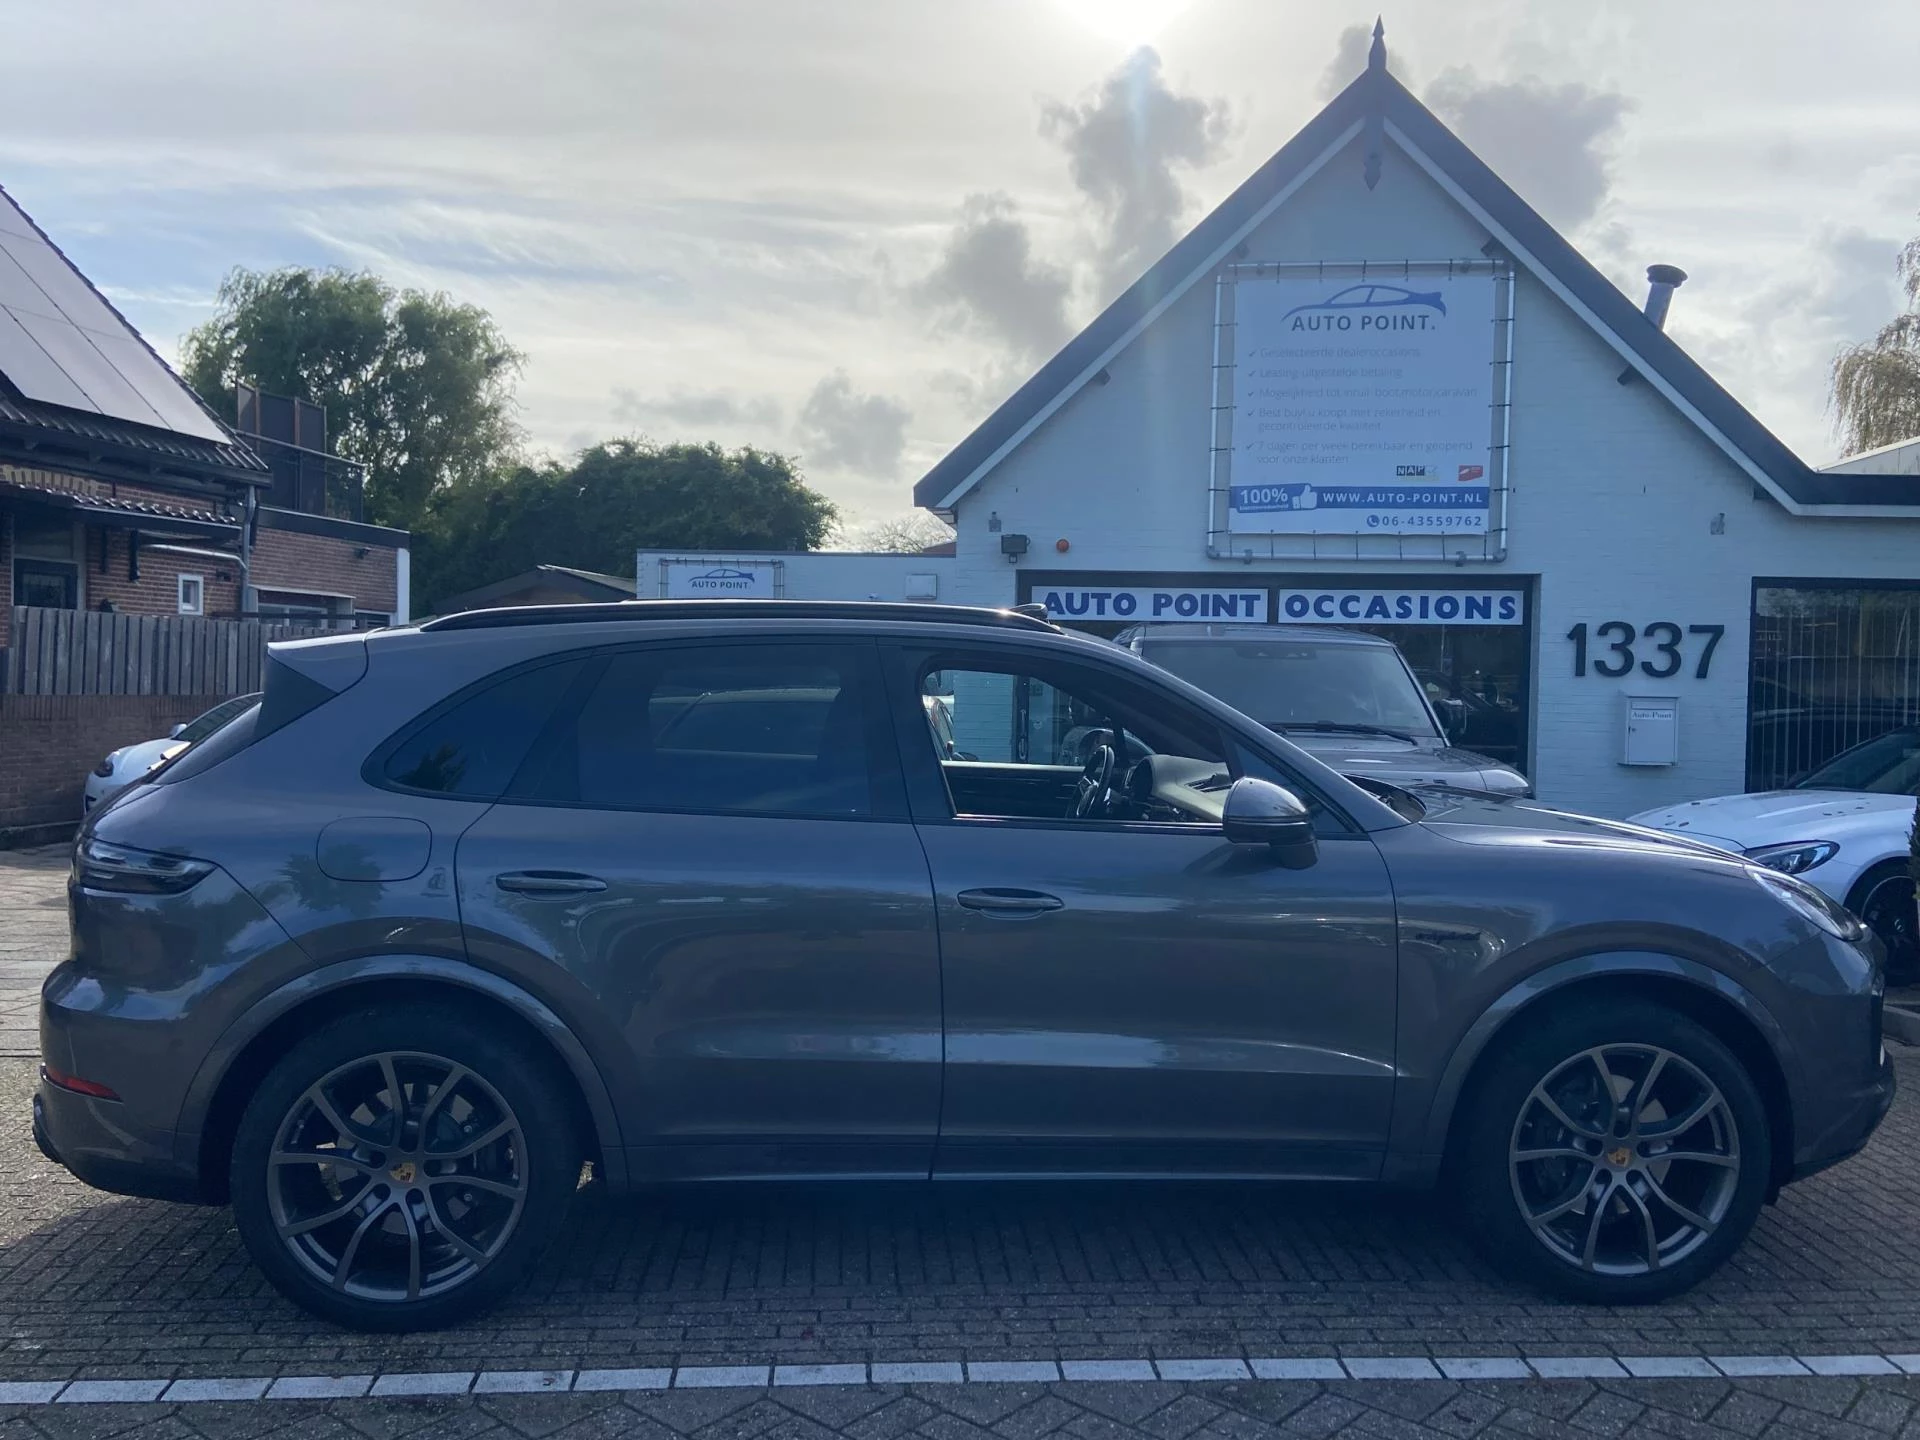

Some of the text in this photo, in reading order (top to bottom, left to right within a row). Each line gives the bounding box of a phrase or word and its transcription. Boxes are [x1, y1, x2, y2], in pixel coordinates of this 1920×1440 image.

[1291, 315, 1351, 331] AUTO
[1326, 387, 1340, 397] tot
[1319, 407, 1347, 420] koopt
[1351, 408, 1370, 417] met
[1256, 455, 1279, 464] voor
[1282, 455, 1308, 464] onze
[1397, 465, 1425, 476] NAP
[1240, 487, 1288, 504] 100%
[1323, 492, 1483, 503] WWW.AUTO-POINT.NL
[1382, 515, 1482, 526] 06-43559762
[691, 581, 717, 589] AUTO
[1045, 592, 1262, 617] AUTO POINT
[1285, 594, 1517, 620] OCCASIONS
[1567, 621, 1725, 679] 1337
